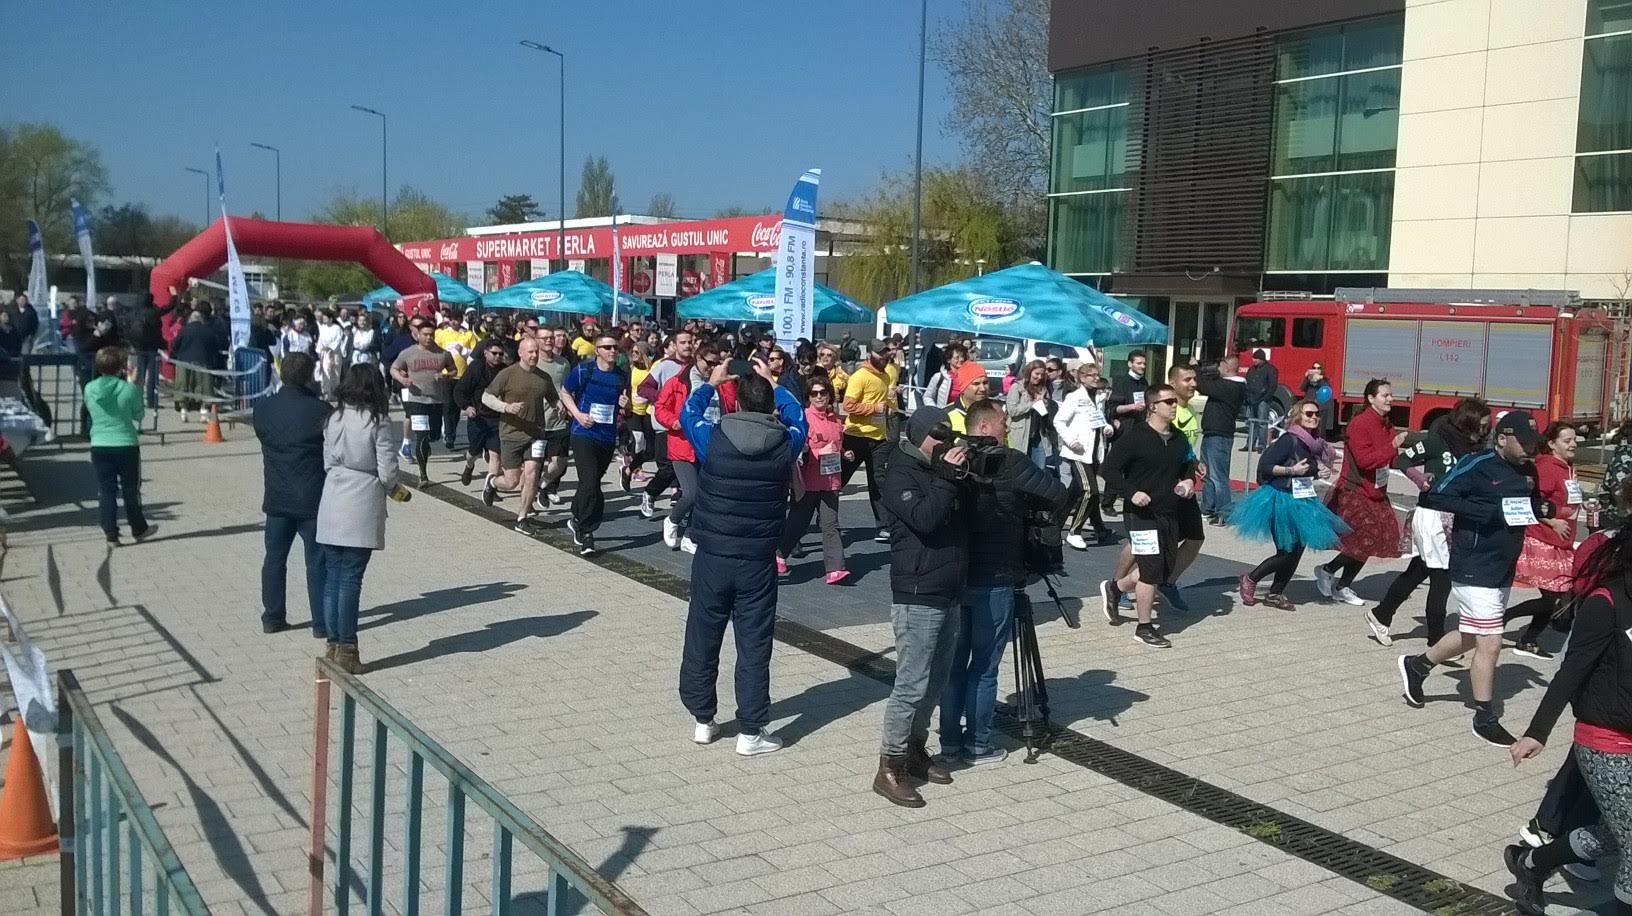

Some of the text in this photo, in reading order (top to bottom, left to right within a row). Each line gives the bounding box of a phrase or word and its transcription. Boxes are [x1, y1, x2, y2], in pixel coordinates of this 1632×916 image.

[670, 231, 705, 247] GUSTUL
[706, 229, 729, 245] UNIC
[788, 235, 796, 253] FM
[476, 237, 551, 259] SUPERMARKET
[785, 255, 796, 278] 90,8
[784, 287, 794, 305] FM
[782, 308, 795, 336] 100,1
[1431, 338, 1472, 348] POMPIERI
